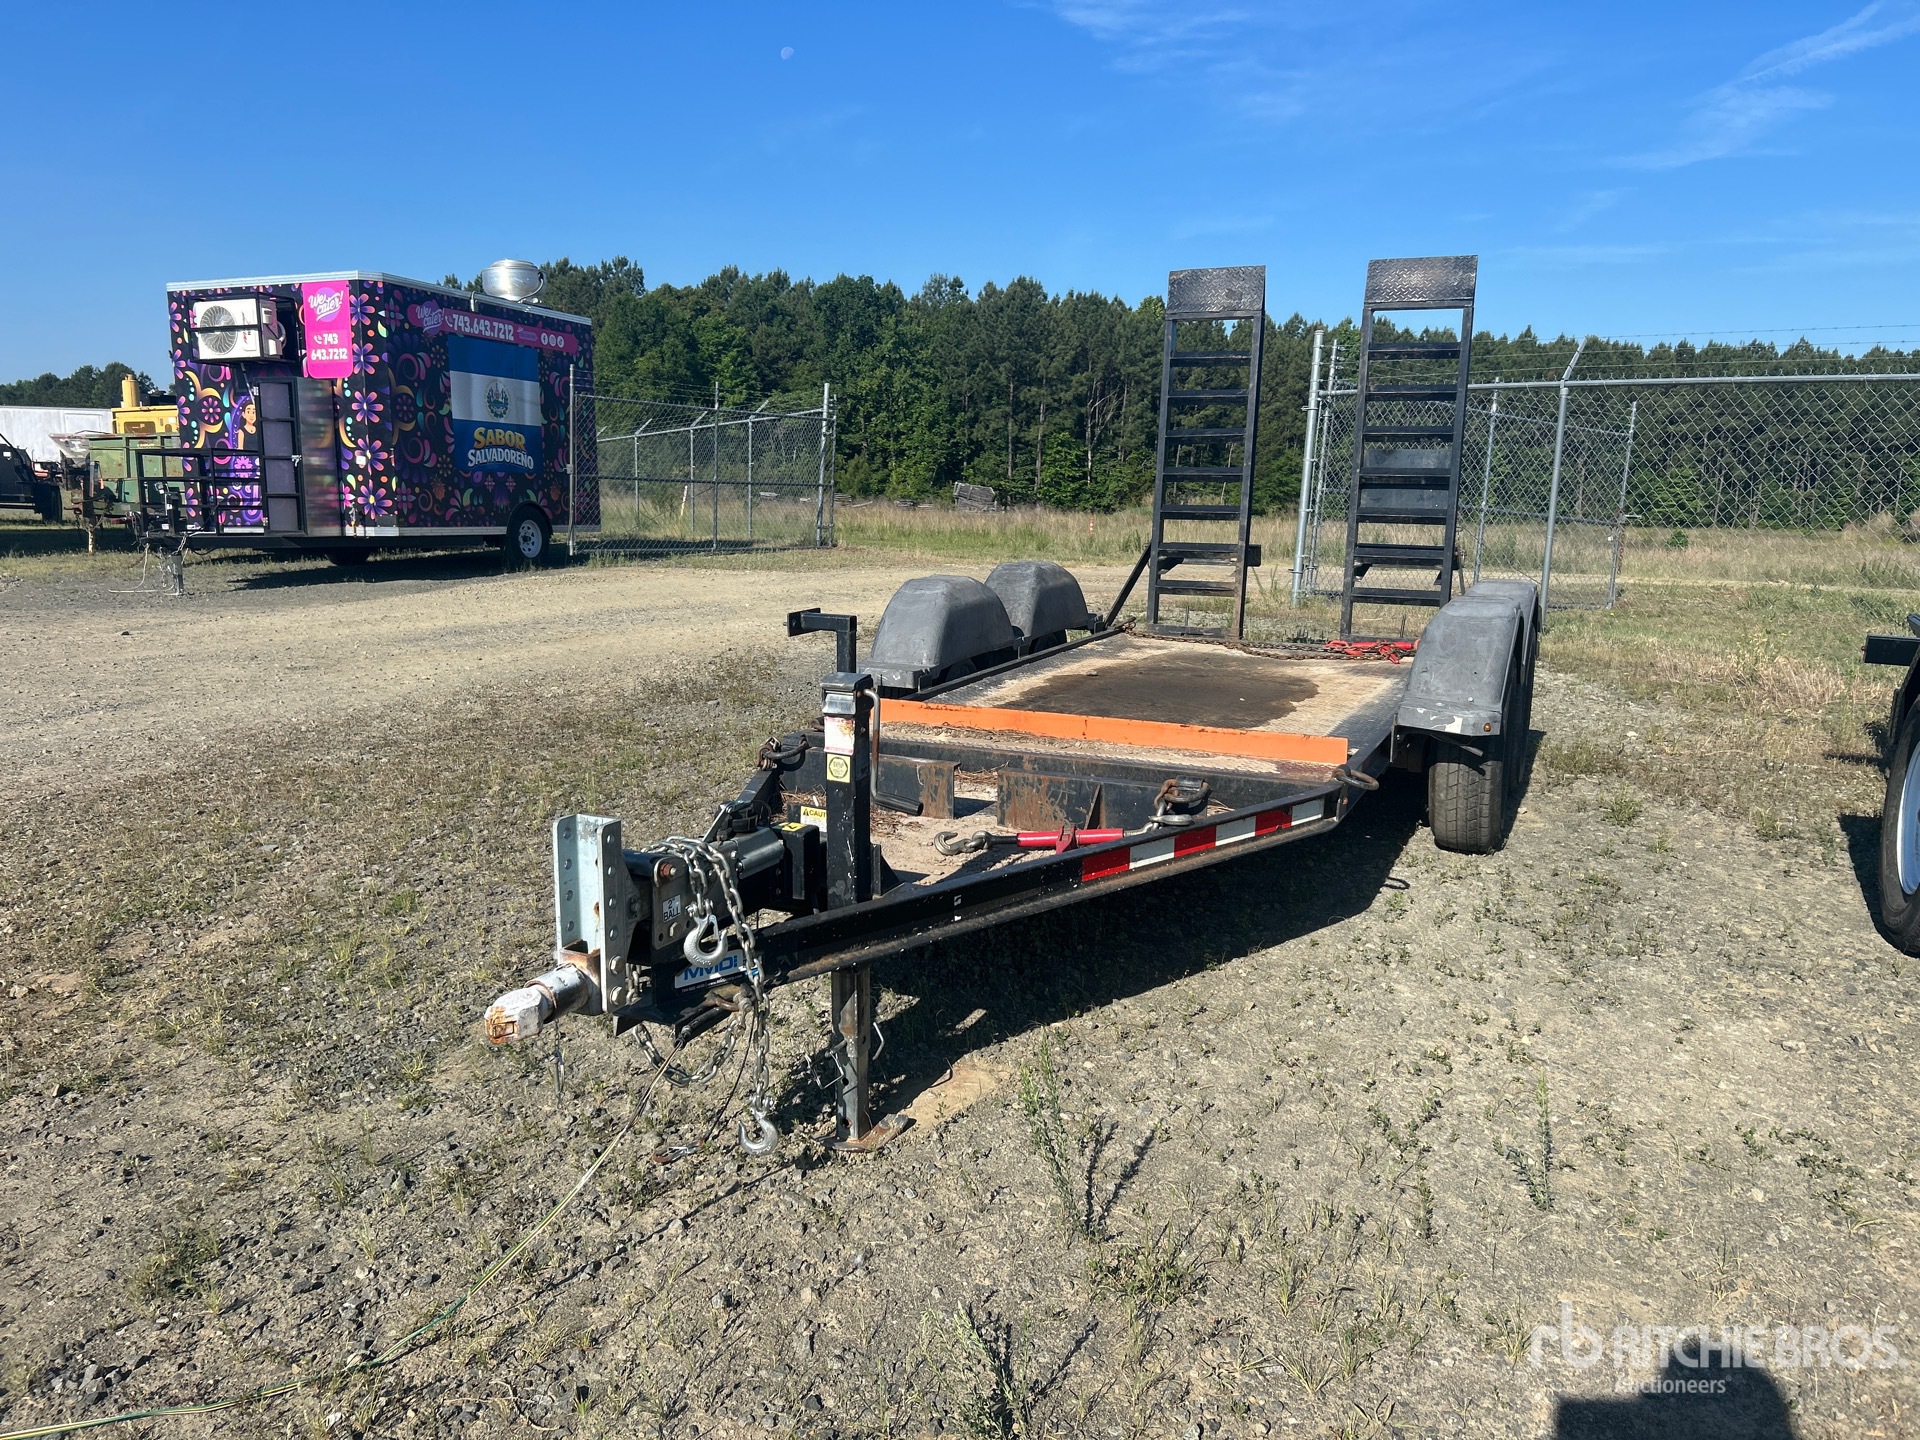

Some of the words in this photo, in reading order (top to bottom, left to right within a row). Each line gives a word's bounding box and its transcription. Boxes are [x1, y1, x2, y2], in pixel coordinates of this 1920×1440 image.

[308, 294, 326, 308] We
[416, 306, 431, 319] We
[452, 314, 515, 341] 743.643.7212
[323, 333, 339, 345] 743
[311, 347, 348, 361] 643.7212
[474, 426, 526, 451] SABOR
[468, 448, 534, 470] SALVADOREÑO
[809, 809, 826, 818] CAUT
[663, 906, 680, 921] BALL
